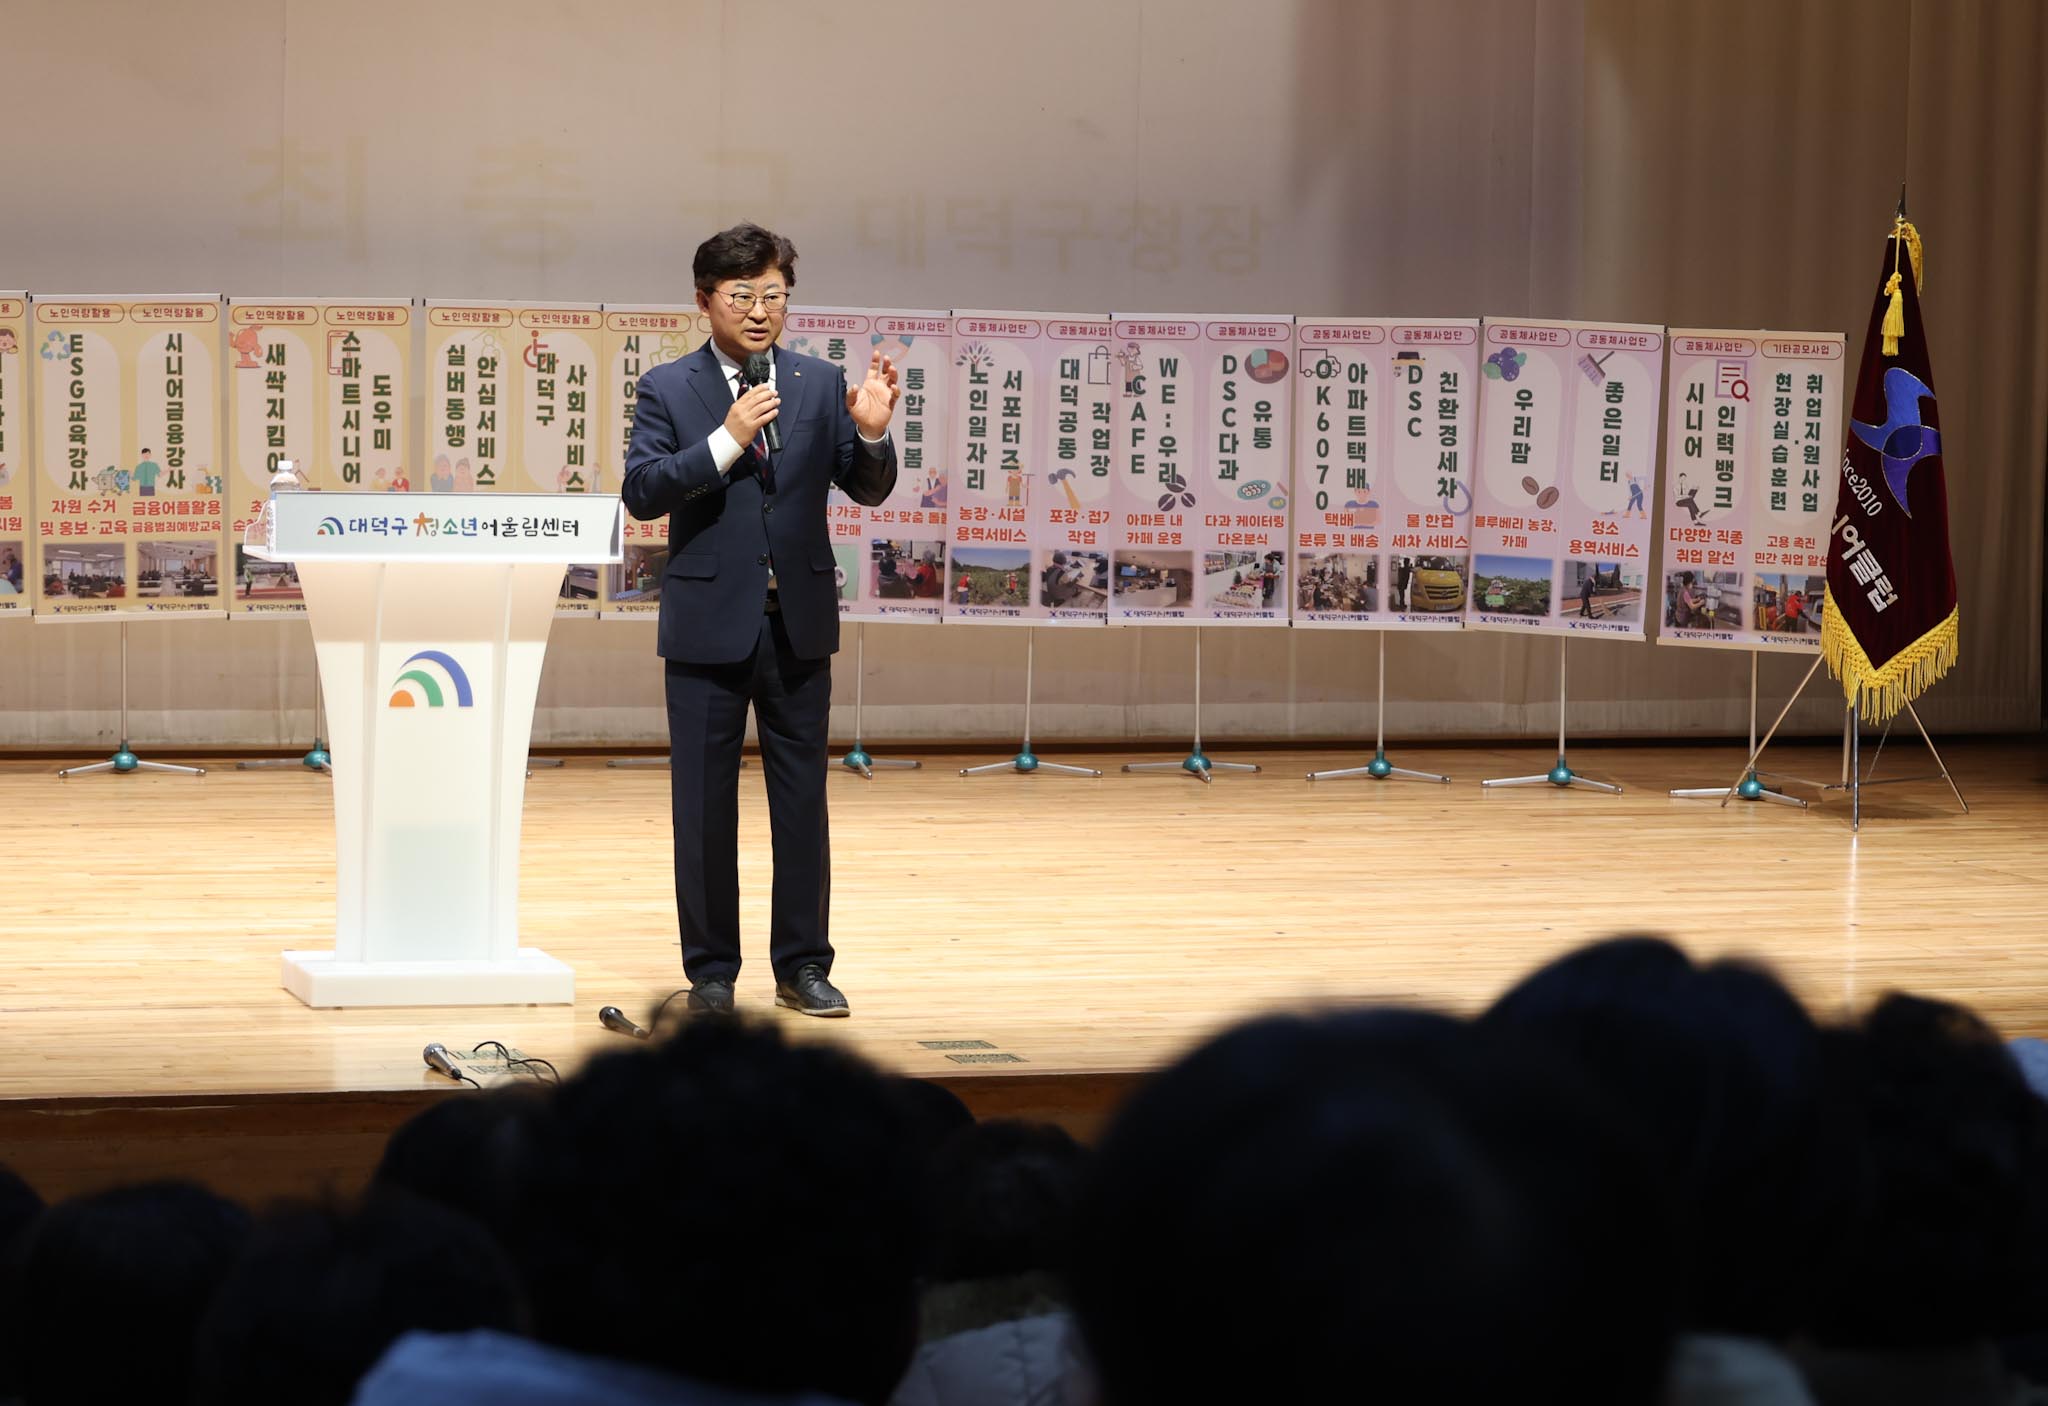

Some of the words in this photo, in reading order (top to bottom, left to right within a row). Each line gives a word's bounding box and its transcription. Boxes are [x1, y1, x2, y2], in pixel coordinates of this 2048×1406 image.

[49, 307, 111, 318] 노인역량활용
[143, 306, 204, 319] 노인역량활용
[245, 310, 305, 321] 노인역량활용
[336, 311, 395, 321] 노인역량활용
[441, 312, 501, 323] 노인역량활용
[531, 314, 591, 325] 노인역량활용
[619, 317, 679, 328] 노인역량활용
[797, 318, 856, 329] 공동체사업단
[887, 321, 946, 332] 공동체사업단
[968, 322, 1028, 334] 공동체사업단
[1059, 325, 1112, 336] 공동체사업
[1128, 325, 1187, 336] 공동체사업단
[1218, 325, 1277, 337] 공동체사업단
[1312, 328, 1372, 340] 공동체사업단
[1403, 329, 1463, 342] 공동체사업단
[1499, 329, 1558, 342] 공동체사업단
[1589, 334, 1648, 347] 공동체사업단
[1686, 341, 1743, 353] 공동체사업단
[1773, 344, 1830, 355] 기타공모사업
[445, 344, 465, 448] 실버동행
[536, 352, 557, 426] 대덕구
[265, 343, 286, 474] 새싹지킴이
[341, 331, 361, 484] 스마트시니어
[1407, 364, 1423, 438] DSC
[68, 334, 88, 491] ESG교육강사
[165, 333, 185, 490] 시니어금융강사
[372, 375, 392, 450] 도우미
[1057, 358, 1080, 460] 대덕공동
[476, 356, 498, 486] 안심서비스
[904, 368, 925, 469] 통합돌봄
[1000, 369, 1023, 471] 서포터즈
[1130, 375, 1147, 474] CAFE
[1218, 354, 1239, 481] DSC다과
[1252, 400, 1273, 450] 유통
[1684, 383, 1704, 458] 시니어
[566, 364, 587, 493] 사회서비스
[966, 363, 988, 491] 노인일자리
[1346, 362, 1368, 490] 아파트택배
[1511, 389, 1533, 464] 우리팜
[1599, 381, 1624, 484] 좋은일터
[1090, 402, 1111, 477] 작업장
[1314, 359, 1333, 511] OK6070
[1437, 371, 1459, 499] 친환경세차
[1770, 372, 1792, 511] 현장실습훈련
[1801, 374, 1823, 512] 취업지원사업
[1714, 405, 1736, 508] 인력뱅크
[51, 499, 82, 514] 자원
[88, 499, 116, 513] 수거
[132, 500, 221, 516] 금융어플활용
[836, 506, 862, 519] 가공
[871, 510, 894, 523] 노인
[900, 511, 924, 524] 맞춤
[1127, 514, 1166, 527] 아파트
[1170, 514, 1183, 527] 내
[1205, 515, 1231, 527] 다과
[1236, 515, 1284, 528] 케이터링
[1325, 513, 1354, 527] 택배
[1407, 514, 1420, 527] 물
[1425, 514, 1454, 528] 한컵
[1475, 515, 1524, 530] 블루베리
[1528, 518, 1557, 533] 농장,
[40, 521, 54, 536] 및
[132, 520, 221, 533] 금융범죄예방교육
[349, 517, 408, 537] 대덕구
[641, 524, 653, 538] 및
[836, 523, 861, 537] 판매
[956, 526, 1027, 542] 용역서비스
[1592, 520, 1619, 535] 청소
[1068, 530, 1096, 544] 작업
[1127, 532, 1153, 544] 카페
[1158, 532, 1182, 545] 운영
[1218, 533, 1268, 545] 다온분식
[1299, 533, 1327, 547] 분류
[1332, 533, 1345, 547] 및
[1351, 533, 1379, 548] 배송
[1392, 534, 1421, 548] 세차
[1427, 534, 1469, 549] 서비스
[1502, 535, 1528, 548] 카페
[1670, 527, 1712, 543] 다양한
[1717, 529, 1743, 545] 직종
[1767, 536, 1789, 549] 고용
[1794, 536, 1816, 550] 촉진
[1569, 540, 1639, 557] 용역서비스
[1676, 549, 1703, 563] 취업
[1708, 550, 1735, 565] 알선
[1755, 552, 1777, 565] 민간
[1781, 553, 1803, 566] 취업
